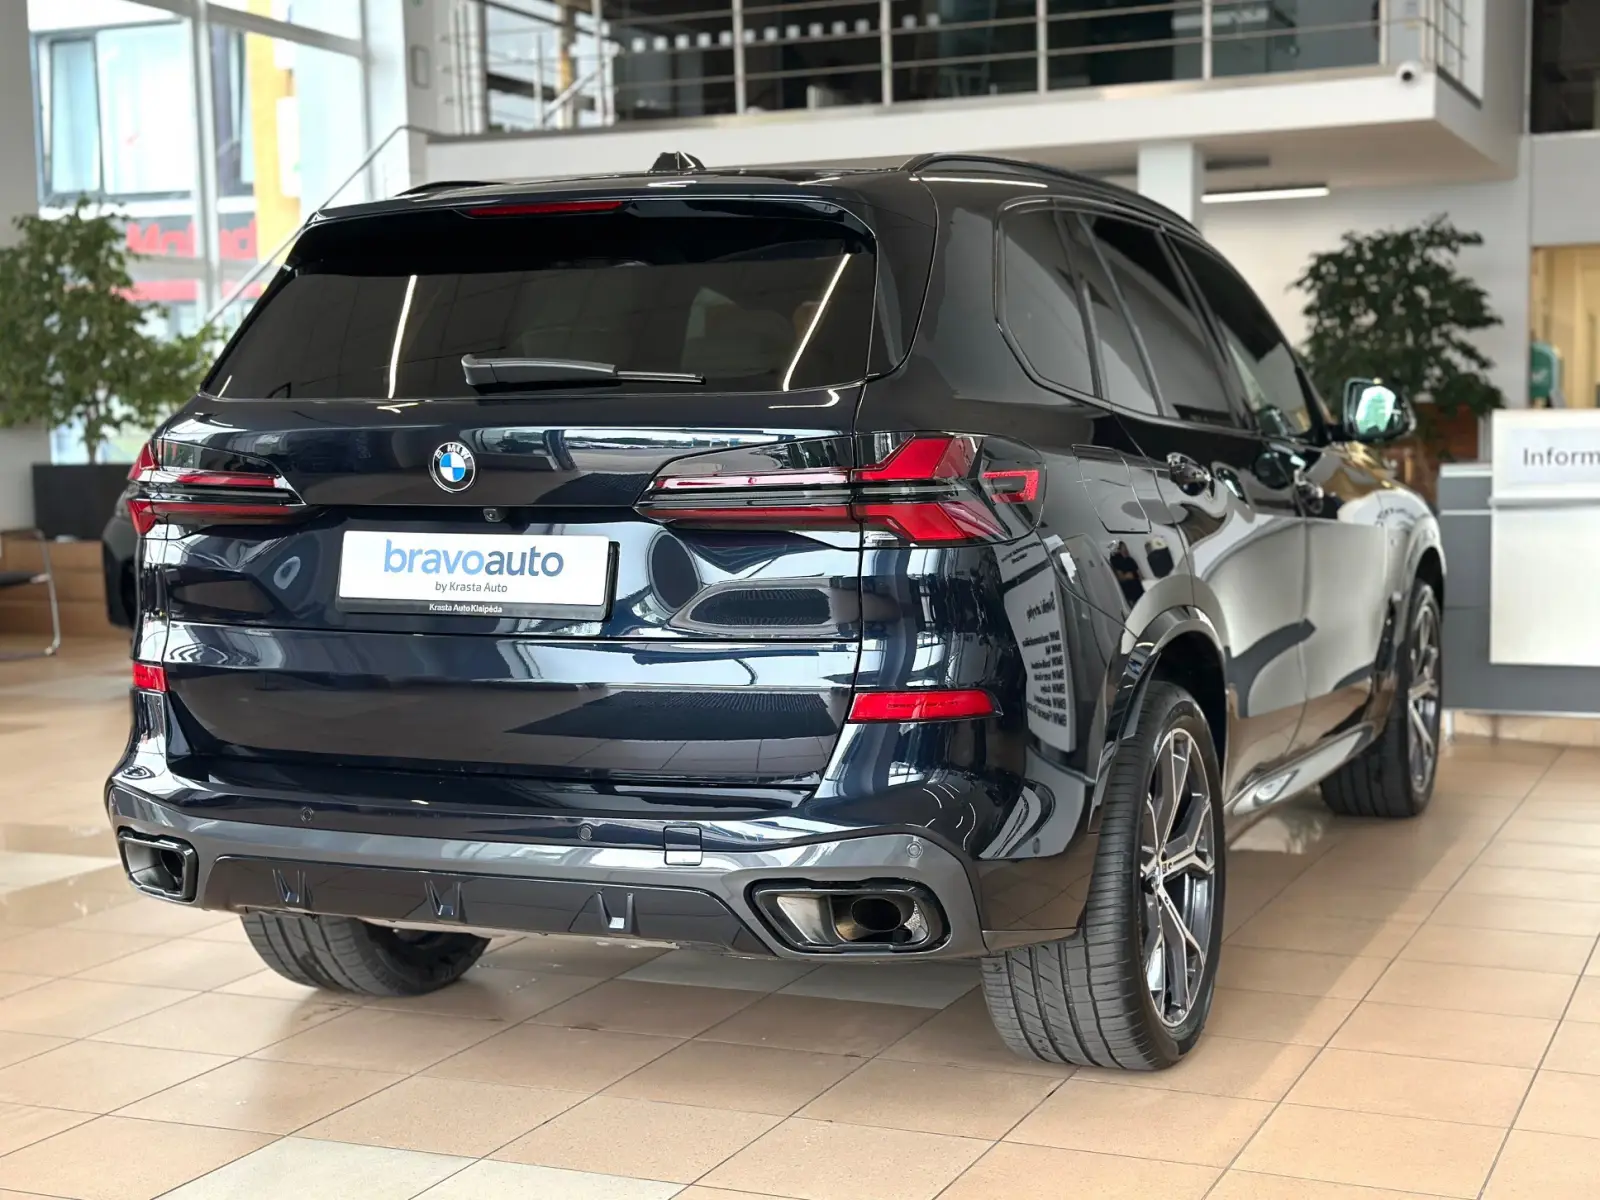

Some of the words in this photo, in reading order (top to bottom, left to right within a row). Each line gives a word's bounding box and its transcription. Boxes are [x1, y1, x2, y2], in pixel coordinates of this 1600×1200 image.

[434, 444, 471, 460] BMW
[1523, 447, 1600, 466] Inform
[384, 539, 564, 577] bravoauto
[435, 581, 448, 594] by
[449, 581, 482, 592] Krasta
[483, 582, 508, 593] Auto
[429, 603, 452, 611] Krasta
[453, 604, 470, 612] Auto
